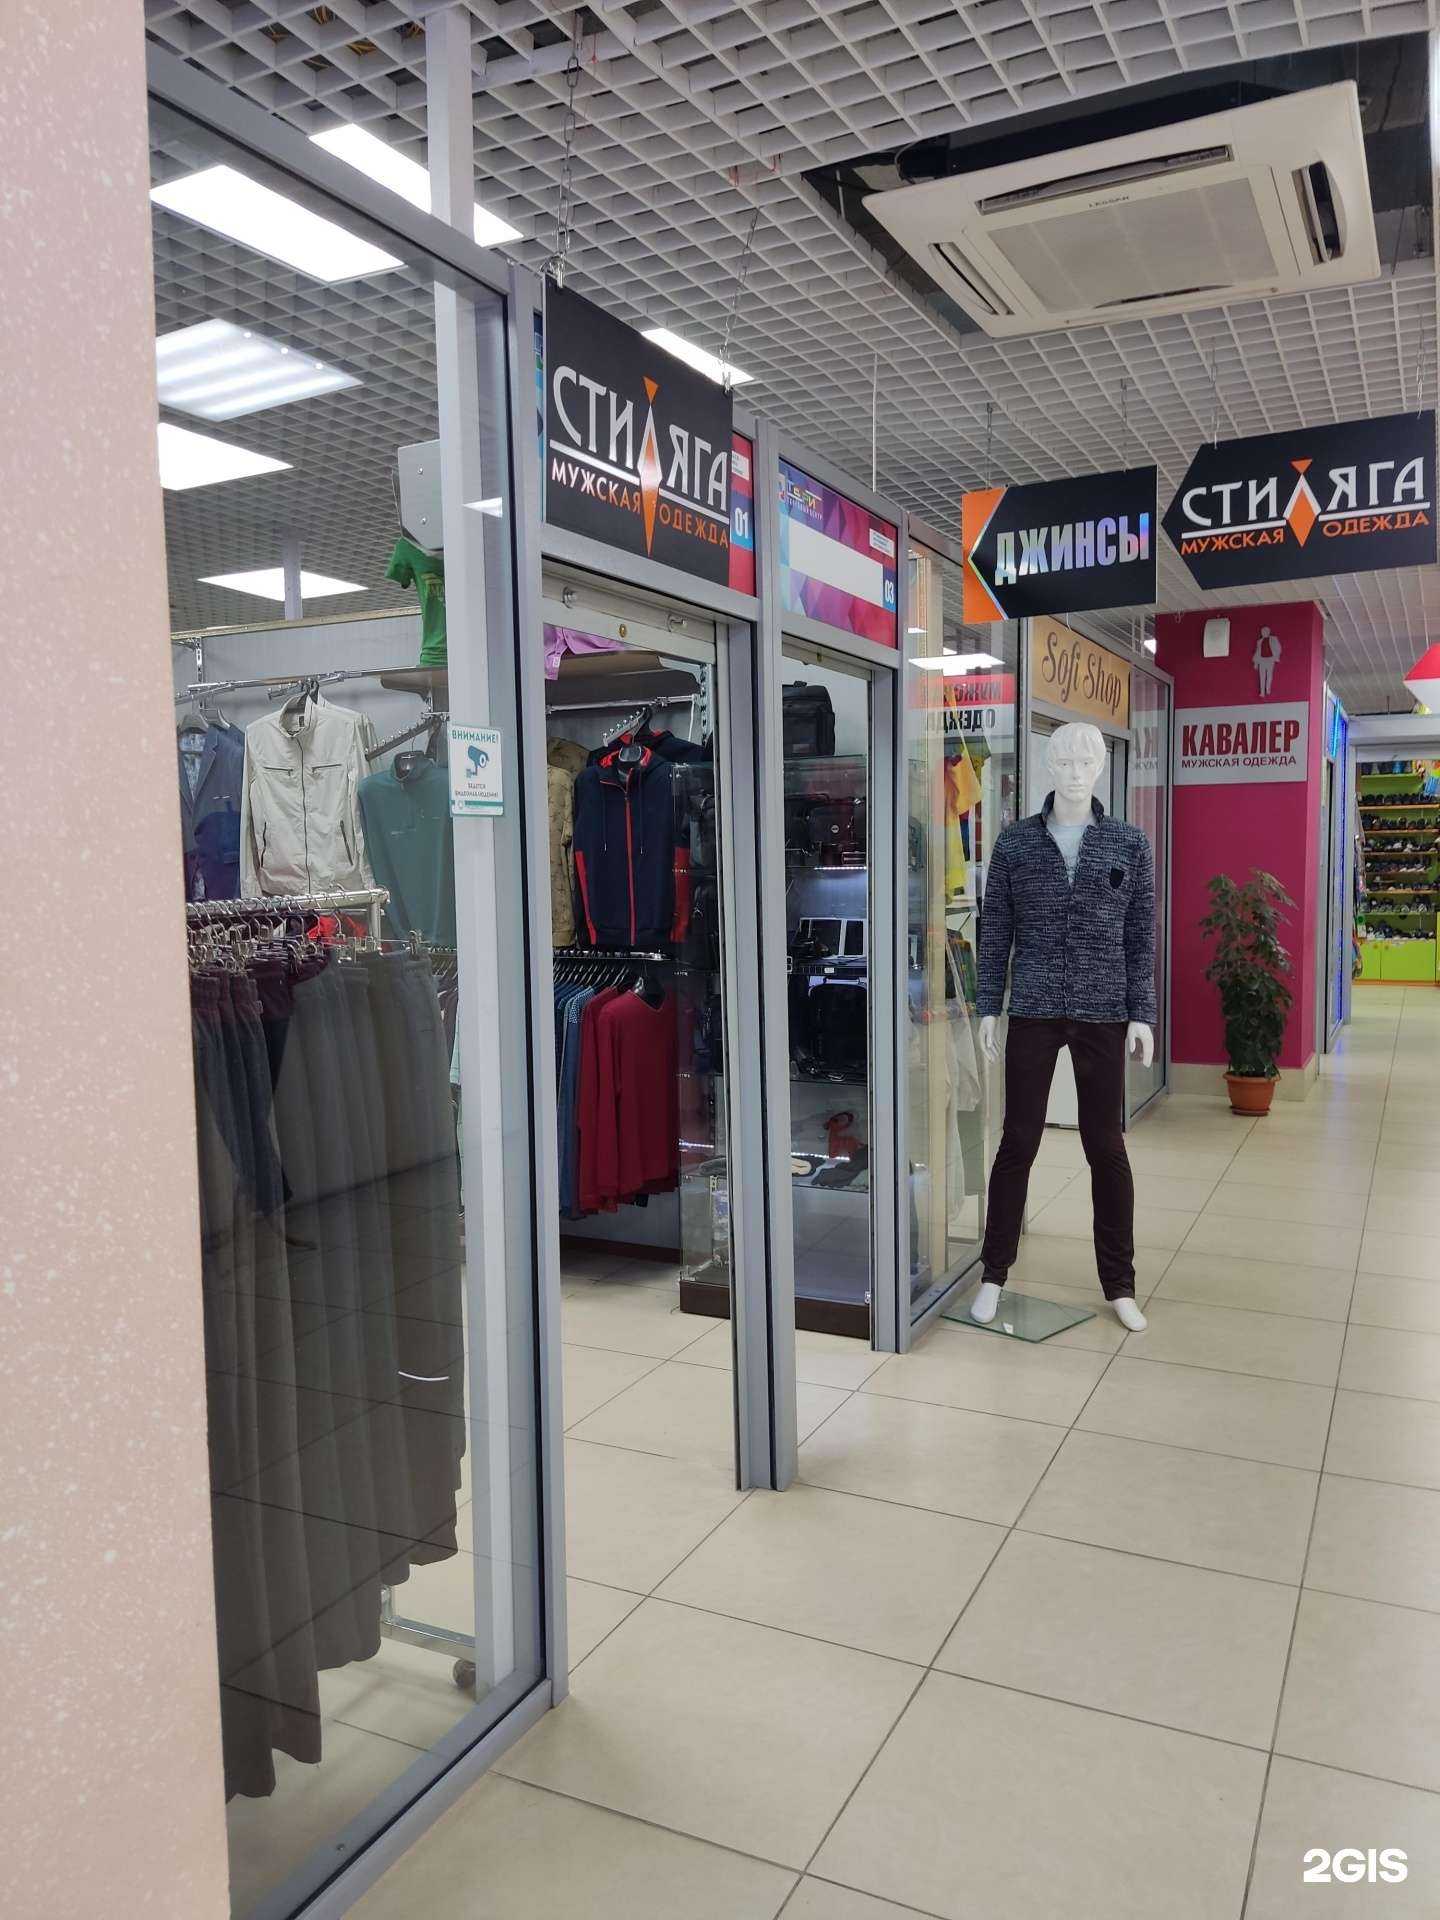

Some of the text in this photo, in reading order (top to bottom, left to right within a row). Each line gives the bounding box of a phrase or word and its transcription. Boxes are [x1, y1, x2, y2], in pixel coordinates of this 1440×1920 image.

[553, 365, 728, 513] СТИЛЯГА
[551, 457, 641, 515] МУЖСКАЯ
[659, 502, 729, 548] ОДЕЖДА
[1181, 456, 1425, 527] СТИЛЯГА
[734, 507, 749, 539] 01
[994, 512, 1150, 586] ДЖИНСЫ
[1181, 511, 1430, 555] МУЖСКАЯ ОДЕЖДА
[884, 579, 895, 604] 03
[1041, 631, 1122, 716] Sofi Shop
[1181, 755, 1297, 768] МУЖСКАЯ ОДЕЖДА
[1182, 720, 1300, 757] КАВАЛЕР
